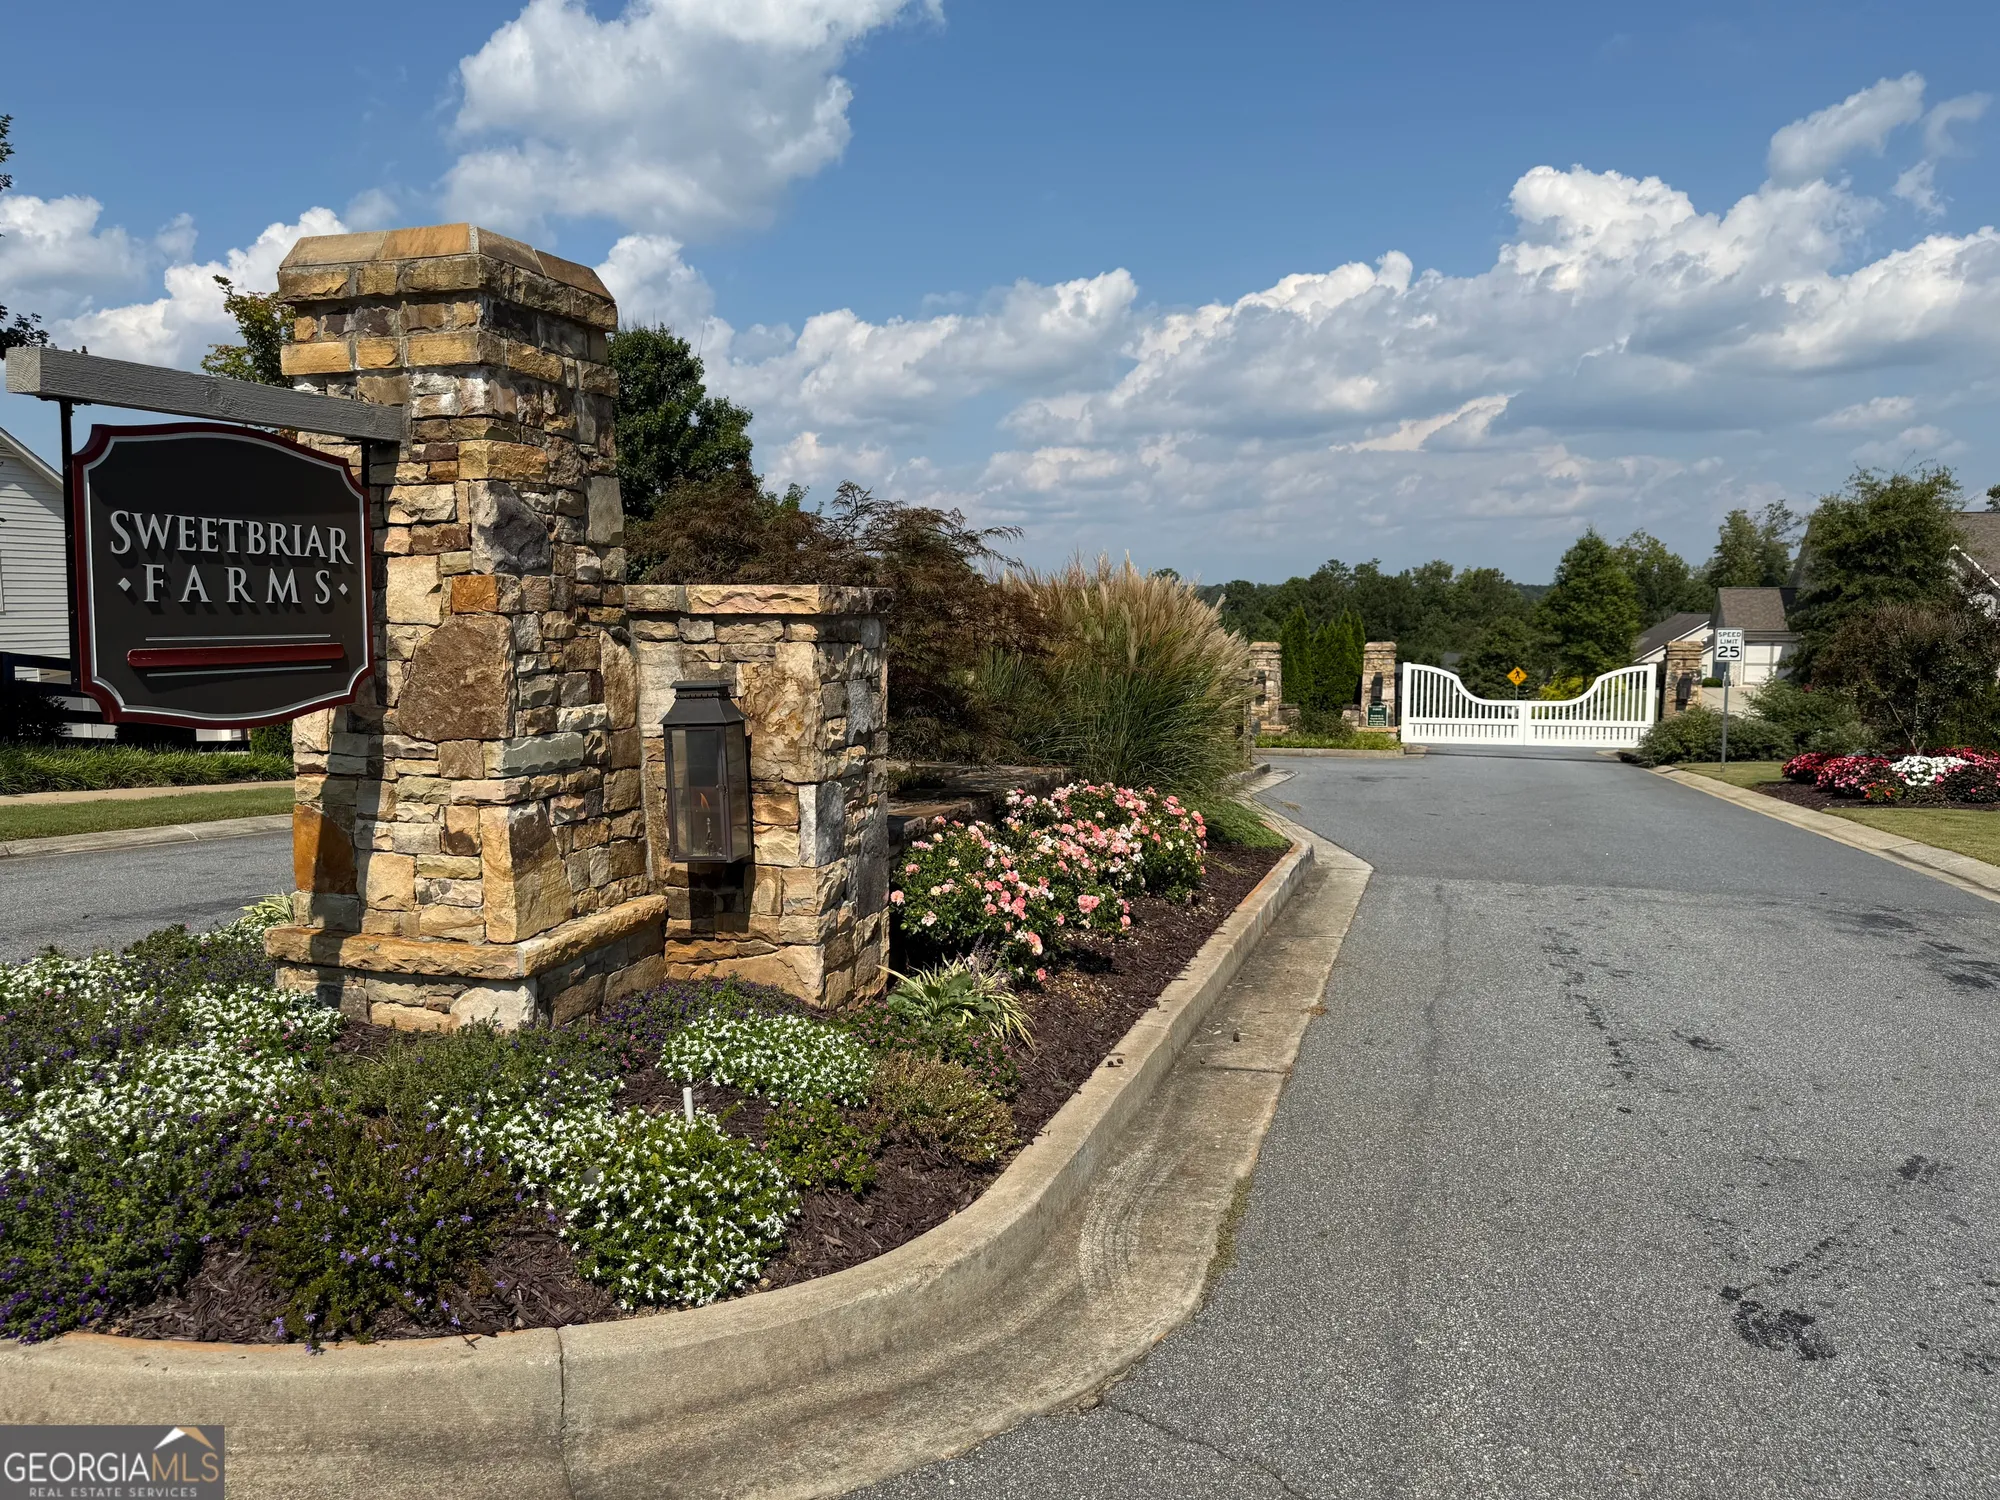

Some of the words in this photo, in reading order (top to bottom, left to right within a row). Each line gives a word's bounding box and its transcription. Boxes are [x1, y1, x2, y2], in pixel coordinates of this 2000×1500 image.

[110, 510, 353, 565] SWEETBRIAR
[142, 563, 332, 605] FARMS
[1717, 646, 1740, 658] 25
